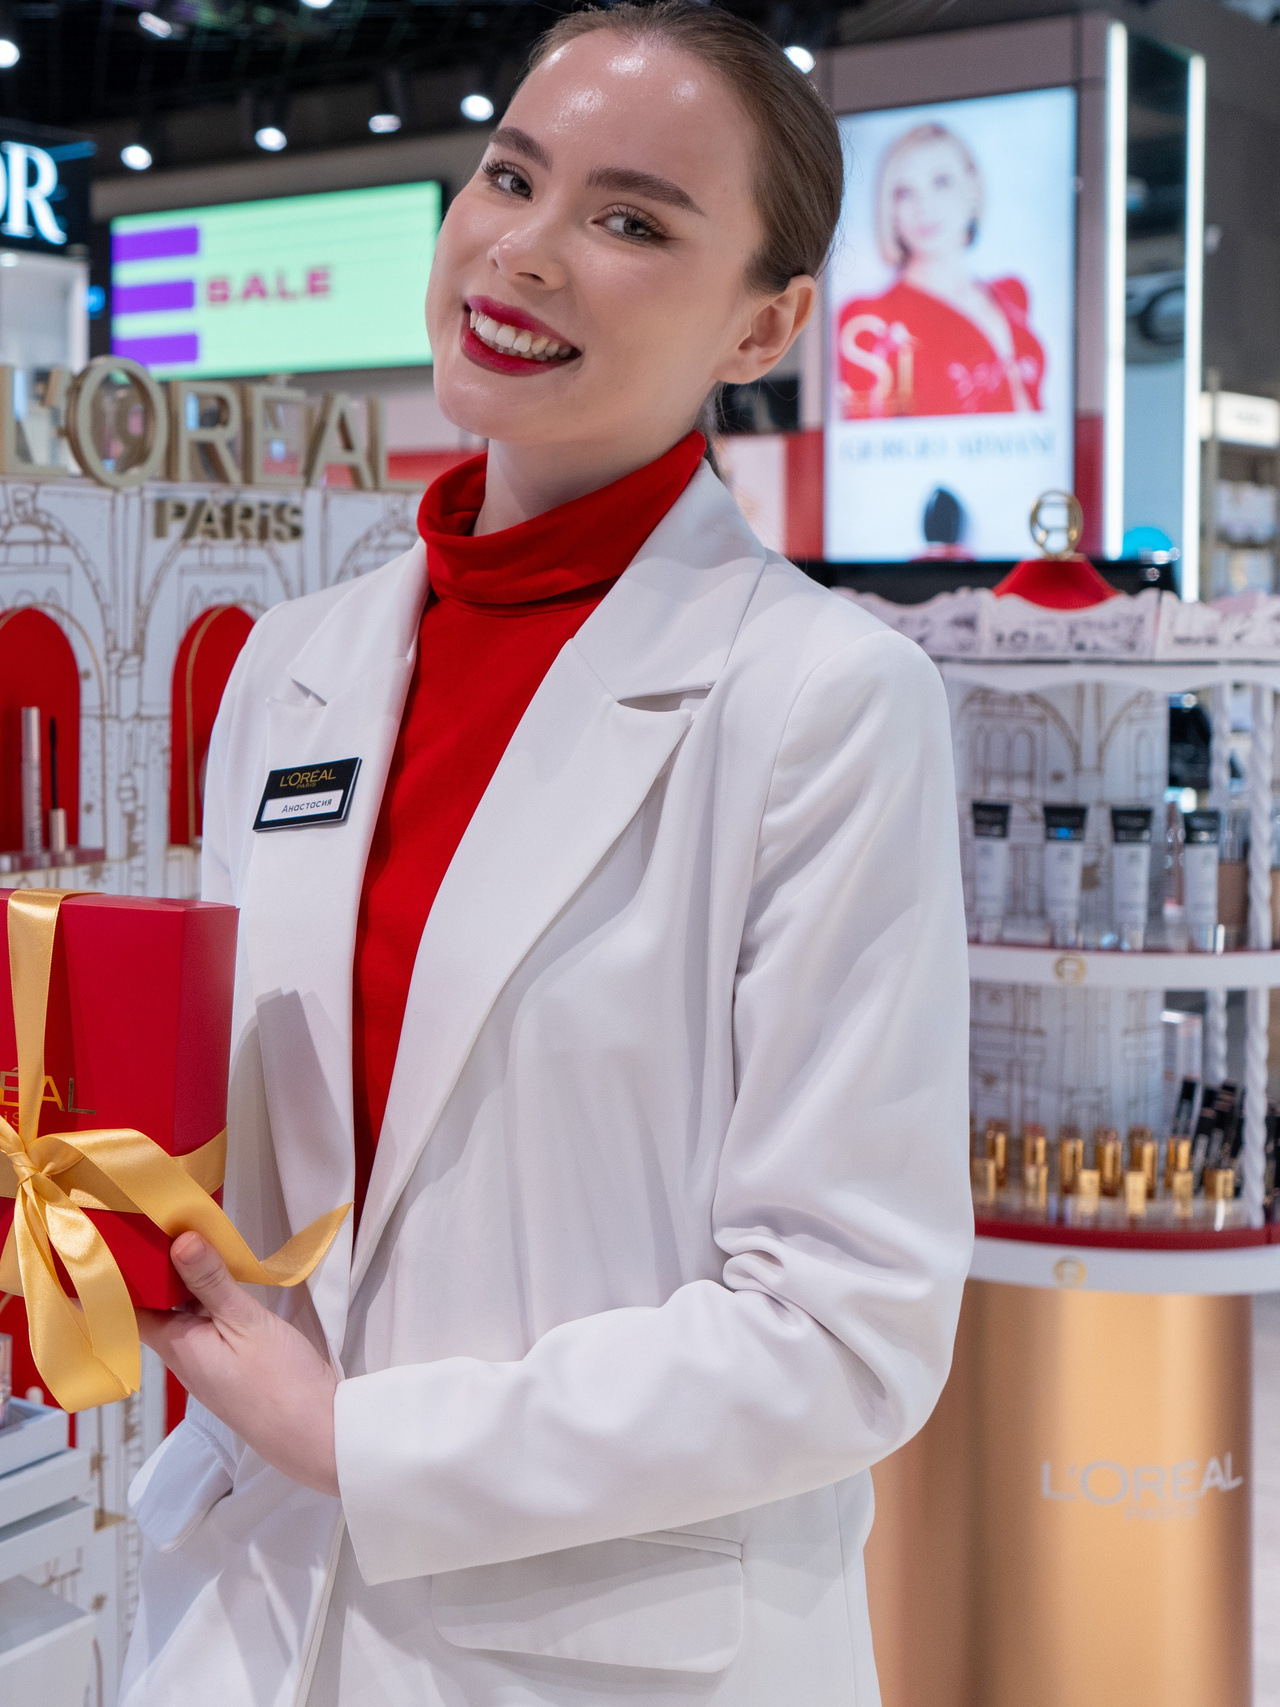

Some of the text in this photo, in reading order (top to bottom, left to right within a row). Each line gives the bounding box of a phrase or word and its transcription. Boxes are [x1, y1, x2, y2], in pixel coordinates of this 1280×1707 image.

[207, 266, 331, 303] SALE
[279, 768, 337, 788] L'ORÉAL
[281, 798, 333, 814] Анастасия
